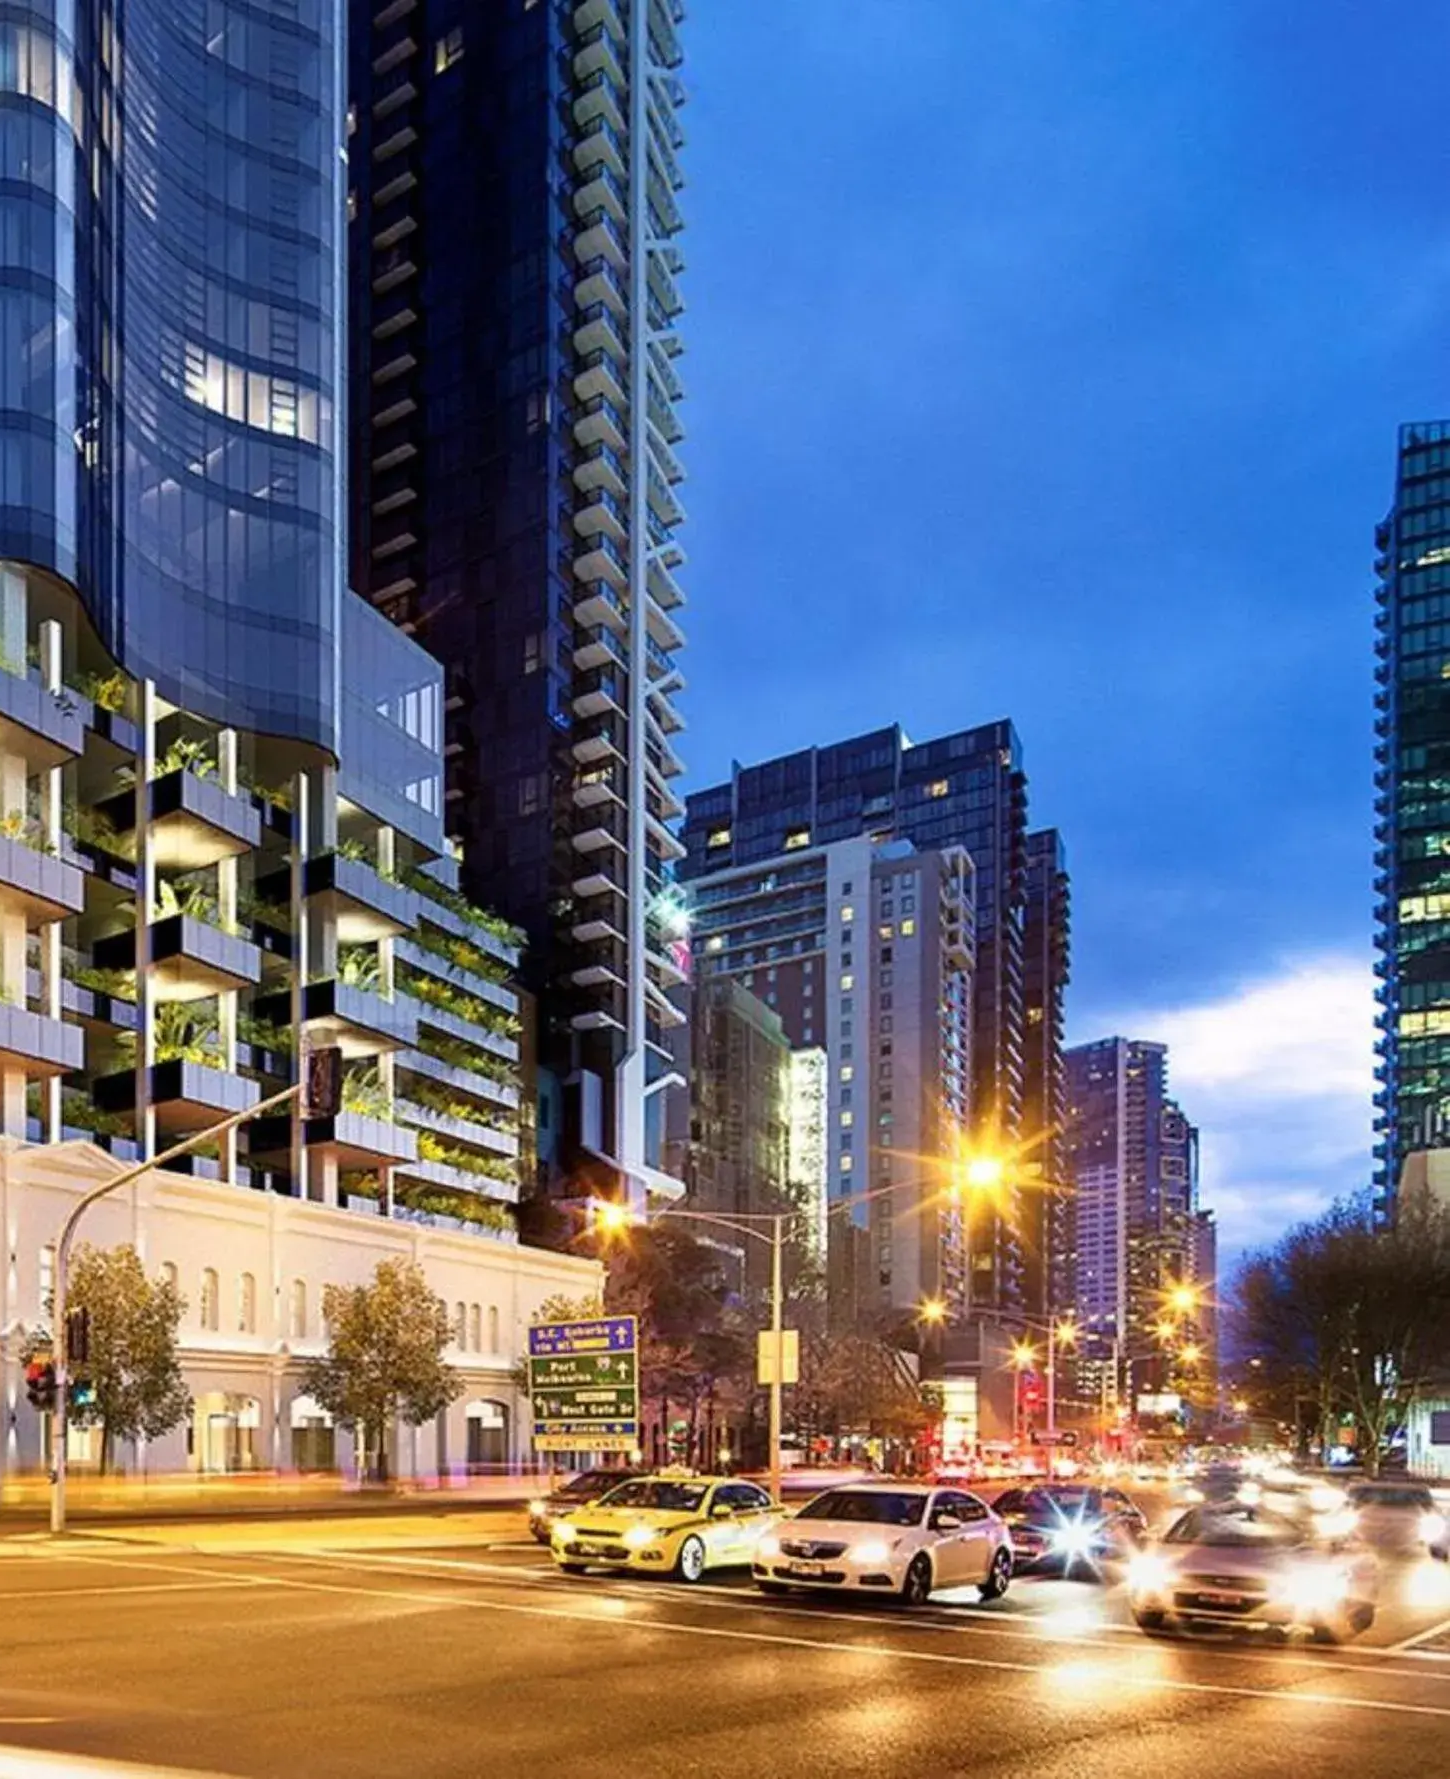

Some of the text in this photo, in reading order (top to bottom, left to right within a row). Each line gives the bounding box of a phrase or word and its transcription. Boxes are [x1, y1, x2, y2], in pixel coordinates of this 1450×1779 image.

[550, 1361, 576, 1372] Port
[536, 1372, 592, 1385] Melbourne
[561, 1403, 586, 1415] West
[589, 1402, 616, 1415] Gate
